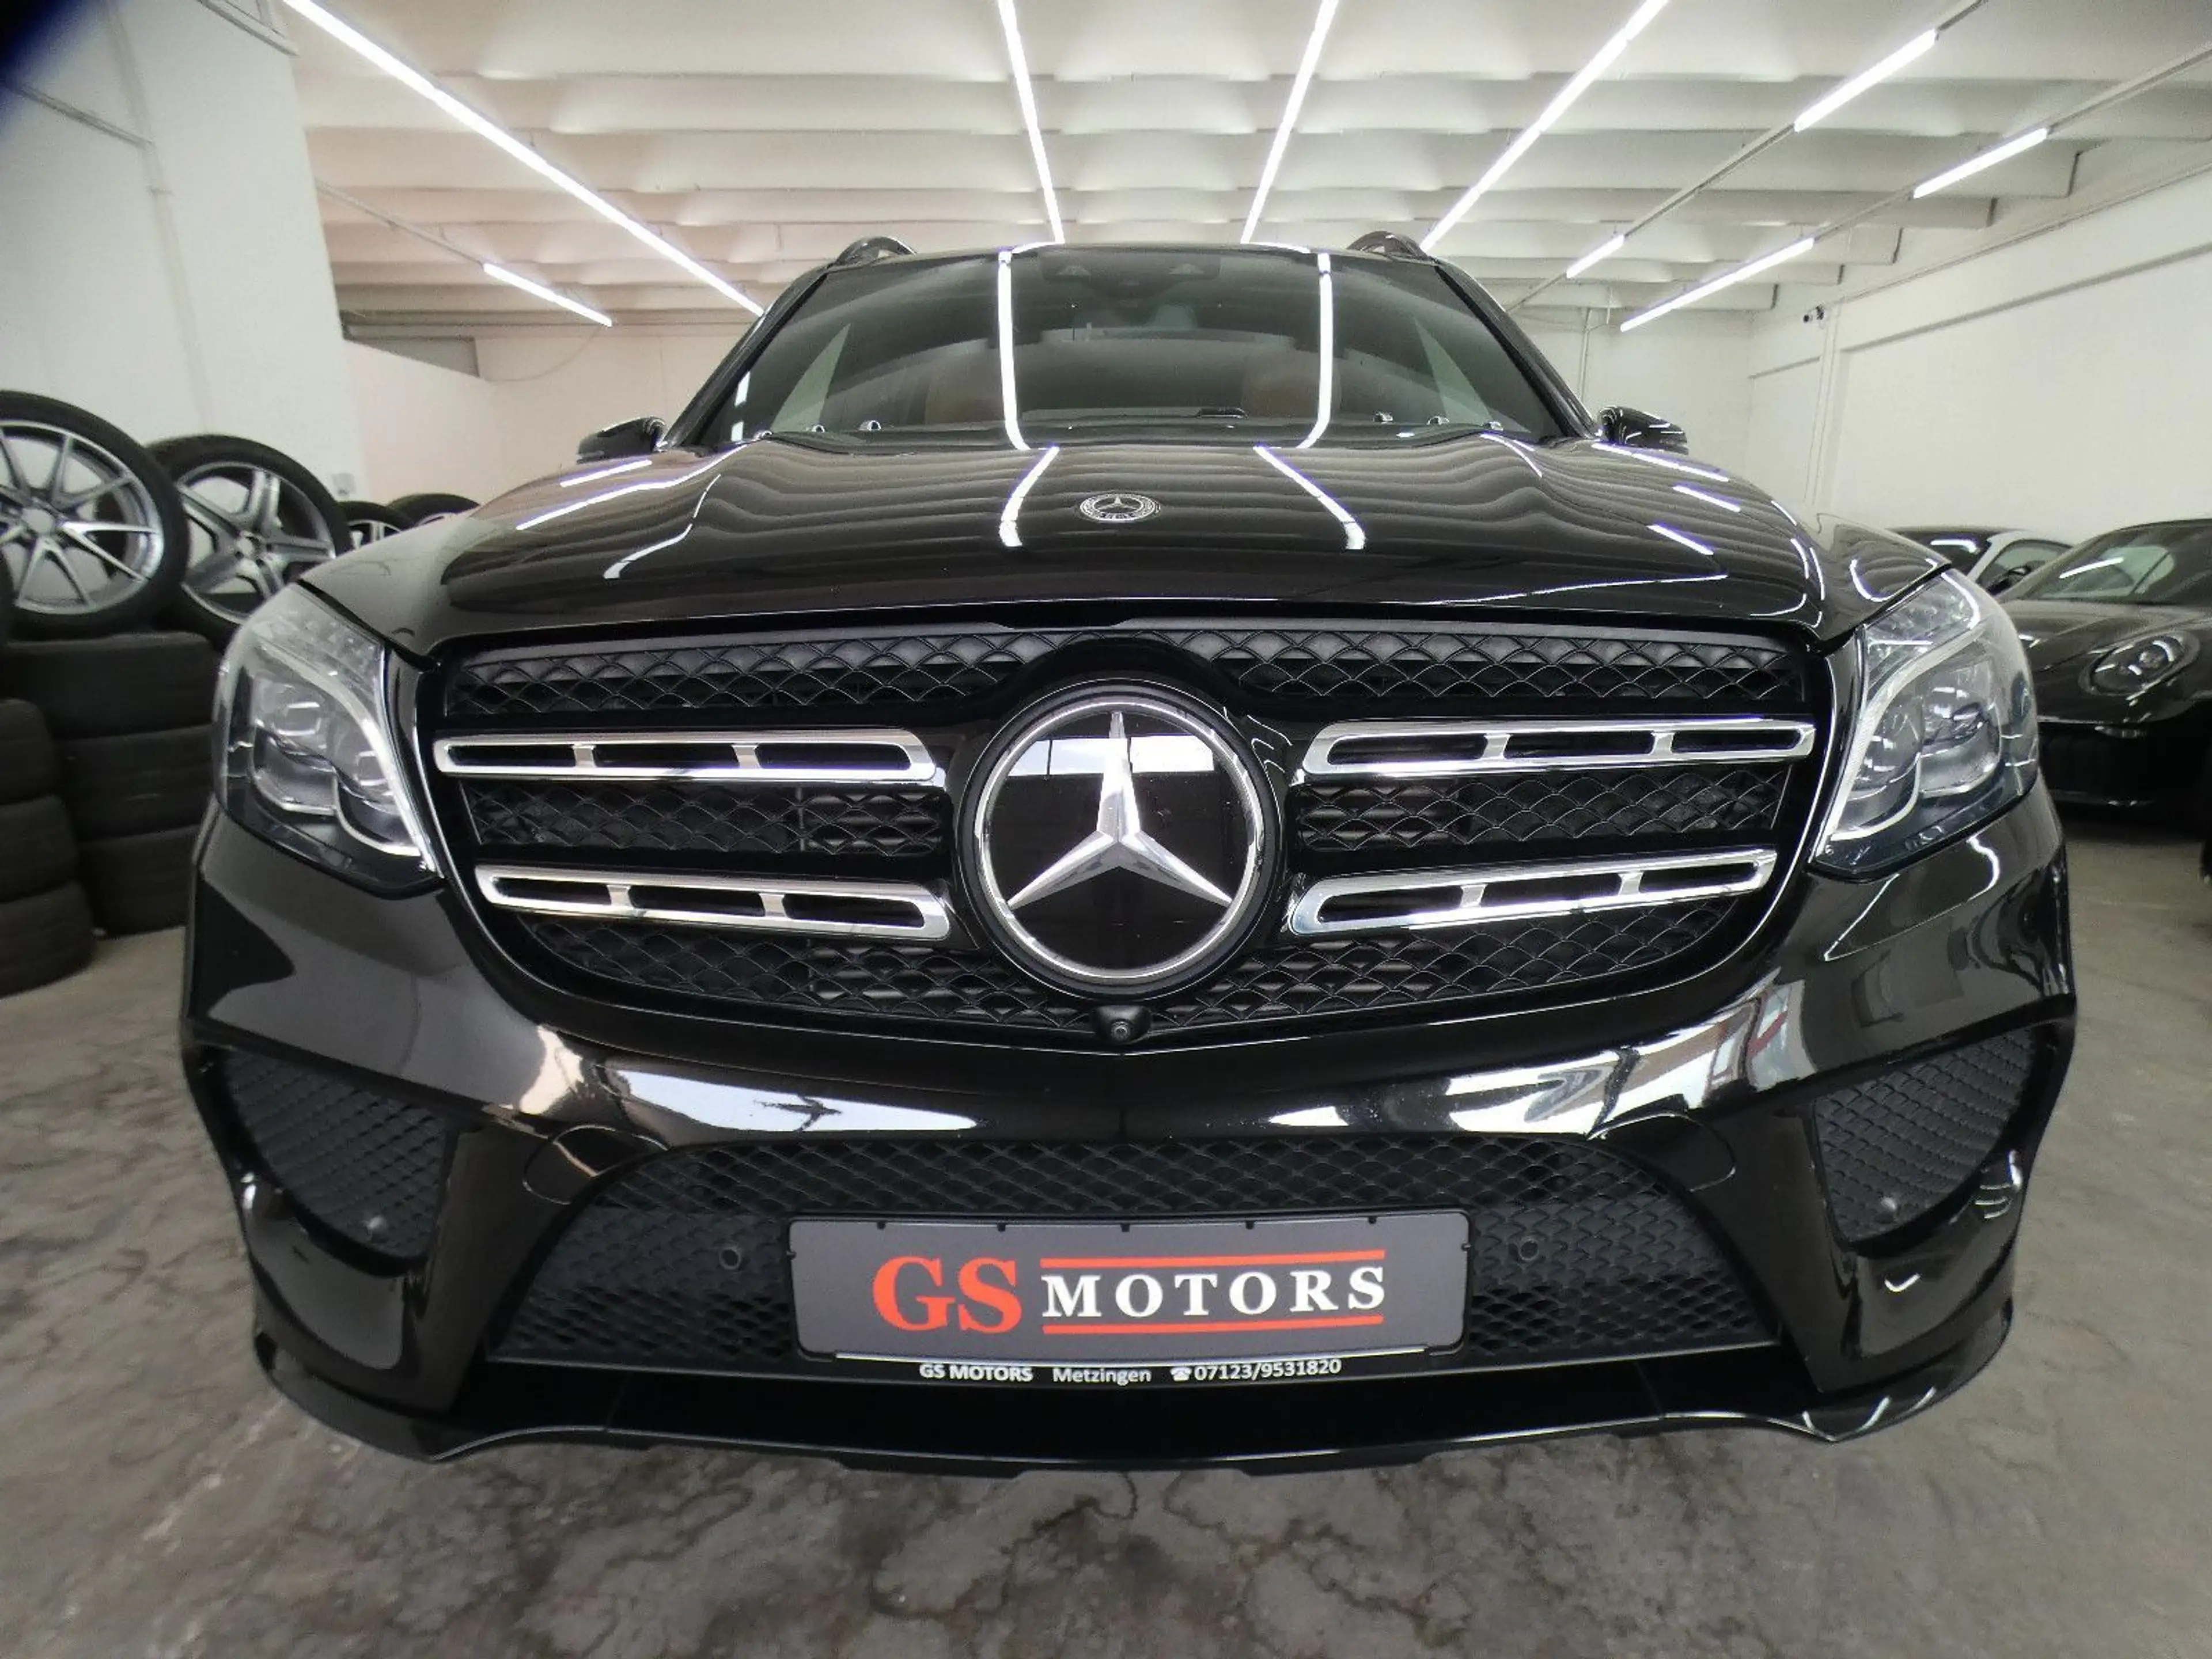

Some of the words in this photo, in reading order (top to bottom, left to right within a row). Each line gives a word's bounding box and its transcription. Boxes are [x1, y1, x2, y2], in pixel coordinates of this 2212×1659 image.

[873, 1255, 1022, 1334] GS
[1041, 1267, 1385, 1317] MOTORS
[919, 1363, 945, 1378] GS
[949, 1365, 1033, 1382] MOTORS
[1052, 1368, 1152, 1386] Metzingen
[1194, 1358, 1342, 1381] 07123/9531820
